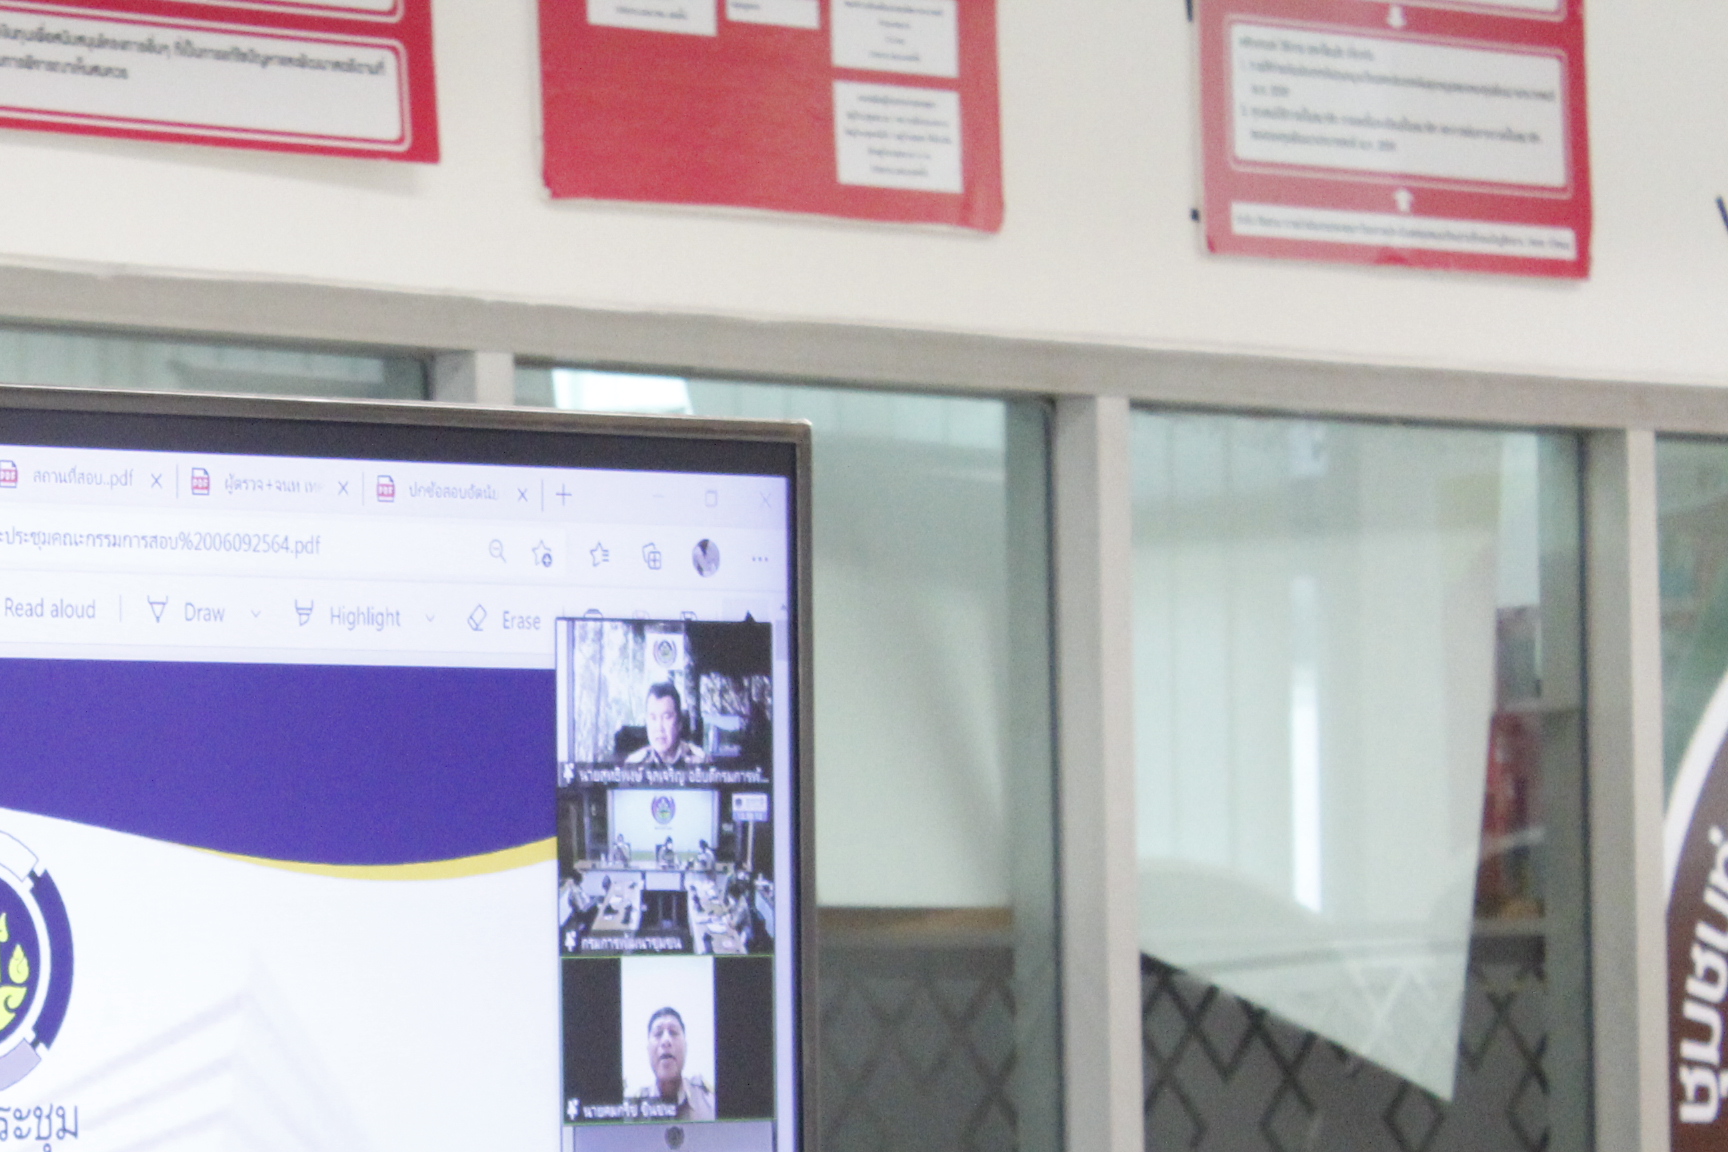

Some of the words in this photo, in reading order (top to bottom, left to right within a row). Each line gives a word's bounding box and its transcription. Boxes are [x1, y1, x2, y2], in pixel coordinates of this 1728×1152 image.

[5, 598, 45, 618] Read
[50, 599, 96, 619] aloud
[184, 603, 225, 623] Draw
[329, 606, 401, 631] Highlight
[503, 611, 542, 631] Erase
